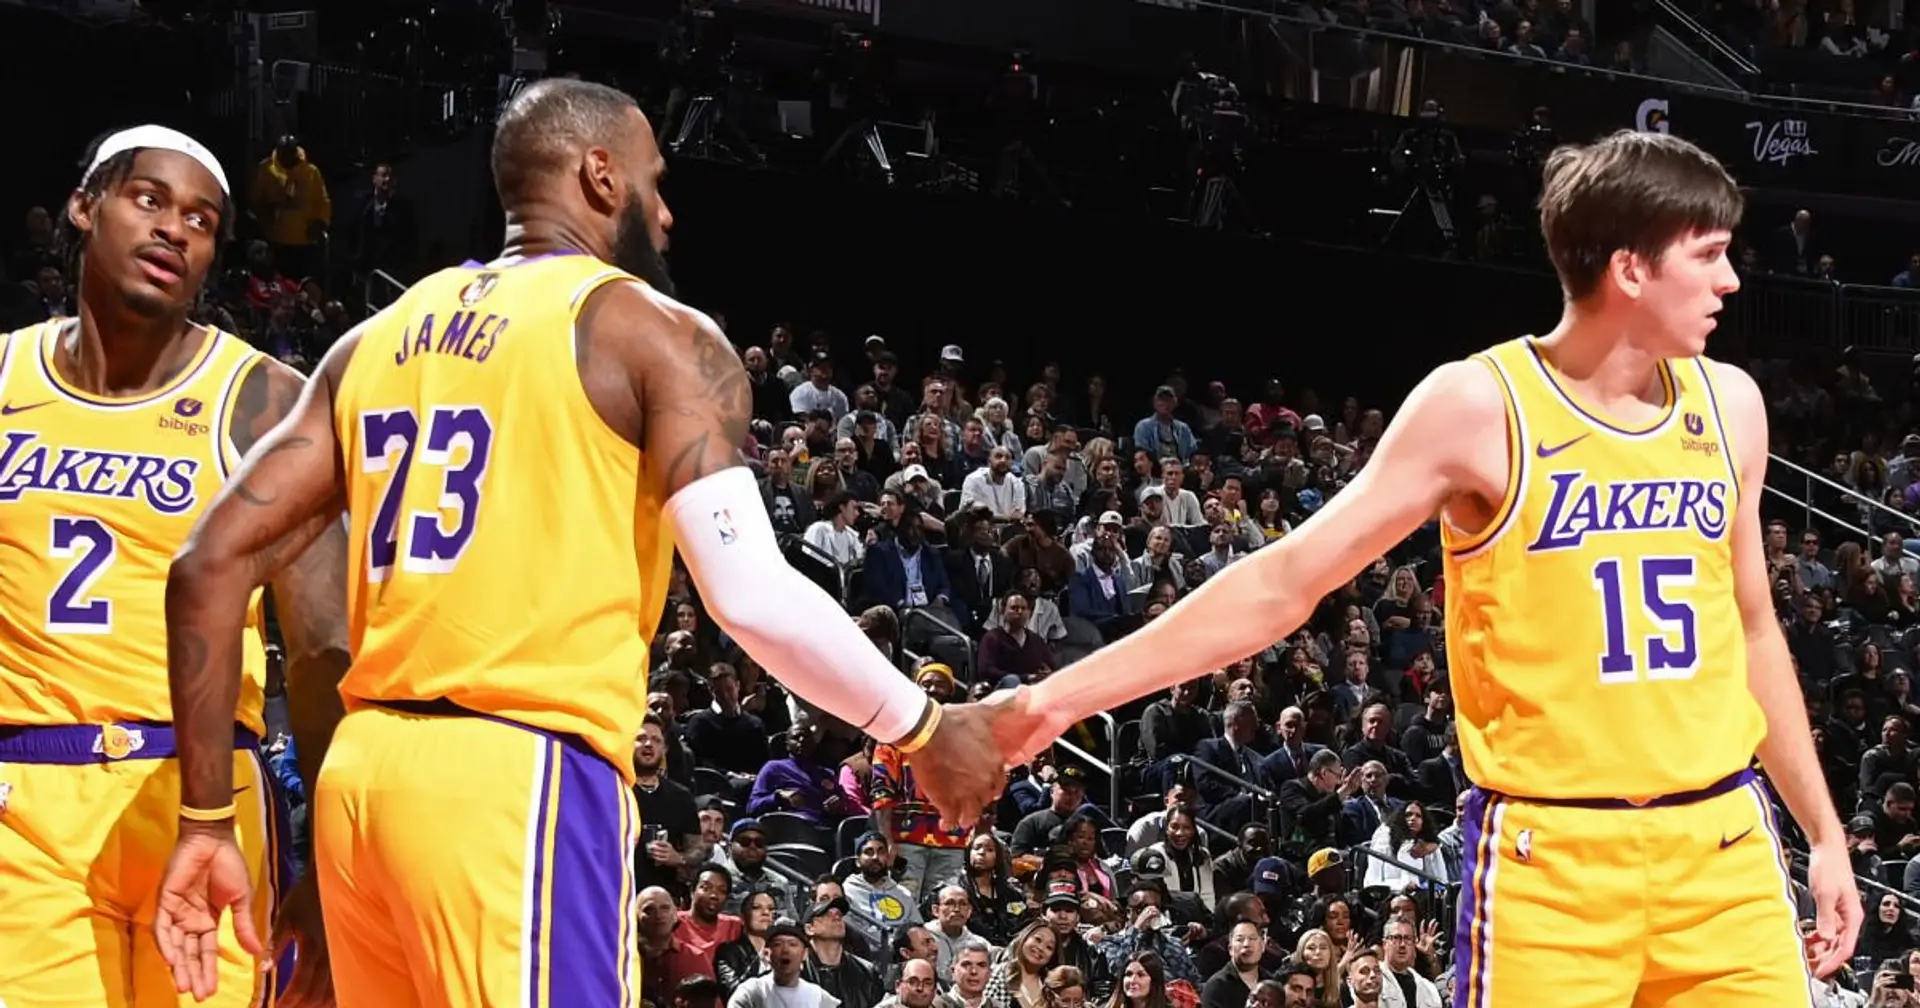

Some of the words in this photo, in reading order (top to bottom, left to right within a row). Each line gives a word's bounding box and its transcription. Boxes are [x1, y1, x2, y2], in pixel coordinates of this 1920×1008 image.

[1745, 121, 1818, 167] Vegas
[395, 311, 508, 366] JAMES
[158, 414, 210, 437] bibigo
[0, 431, 199, 515] LAKERS
[360, 405, 493, 582] 23
[1525, 470, 1729, 554] LAKERS
[47, 516, 115, 631] 2
[1593, 556, 1700, 681] 15
